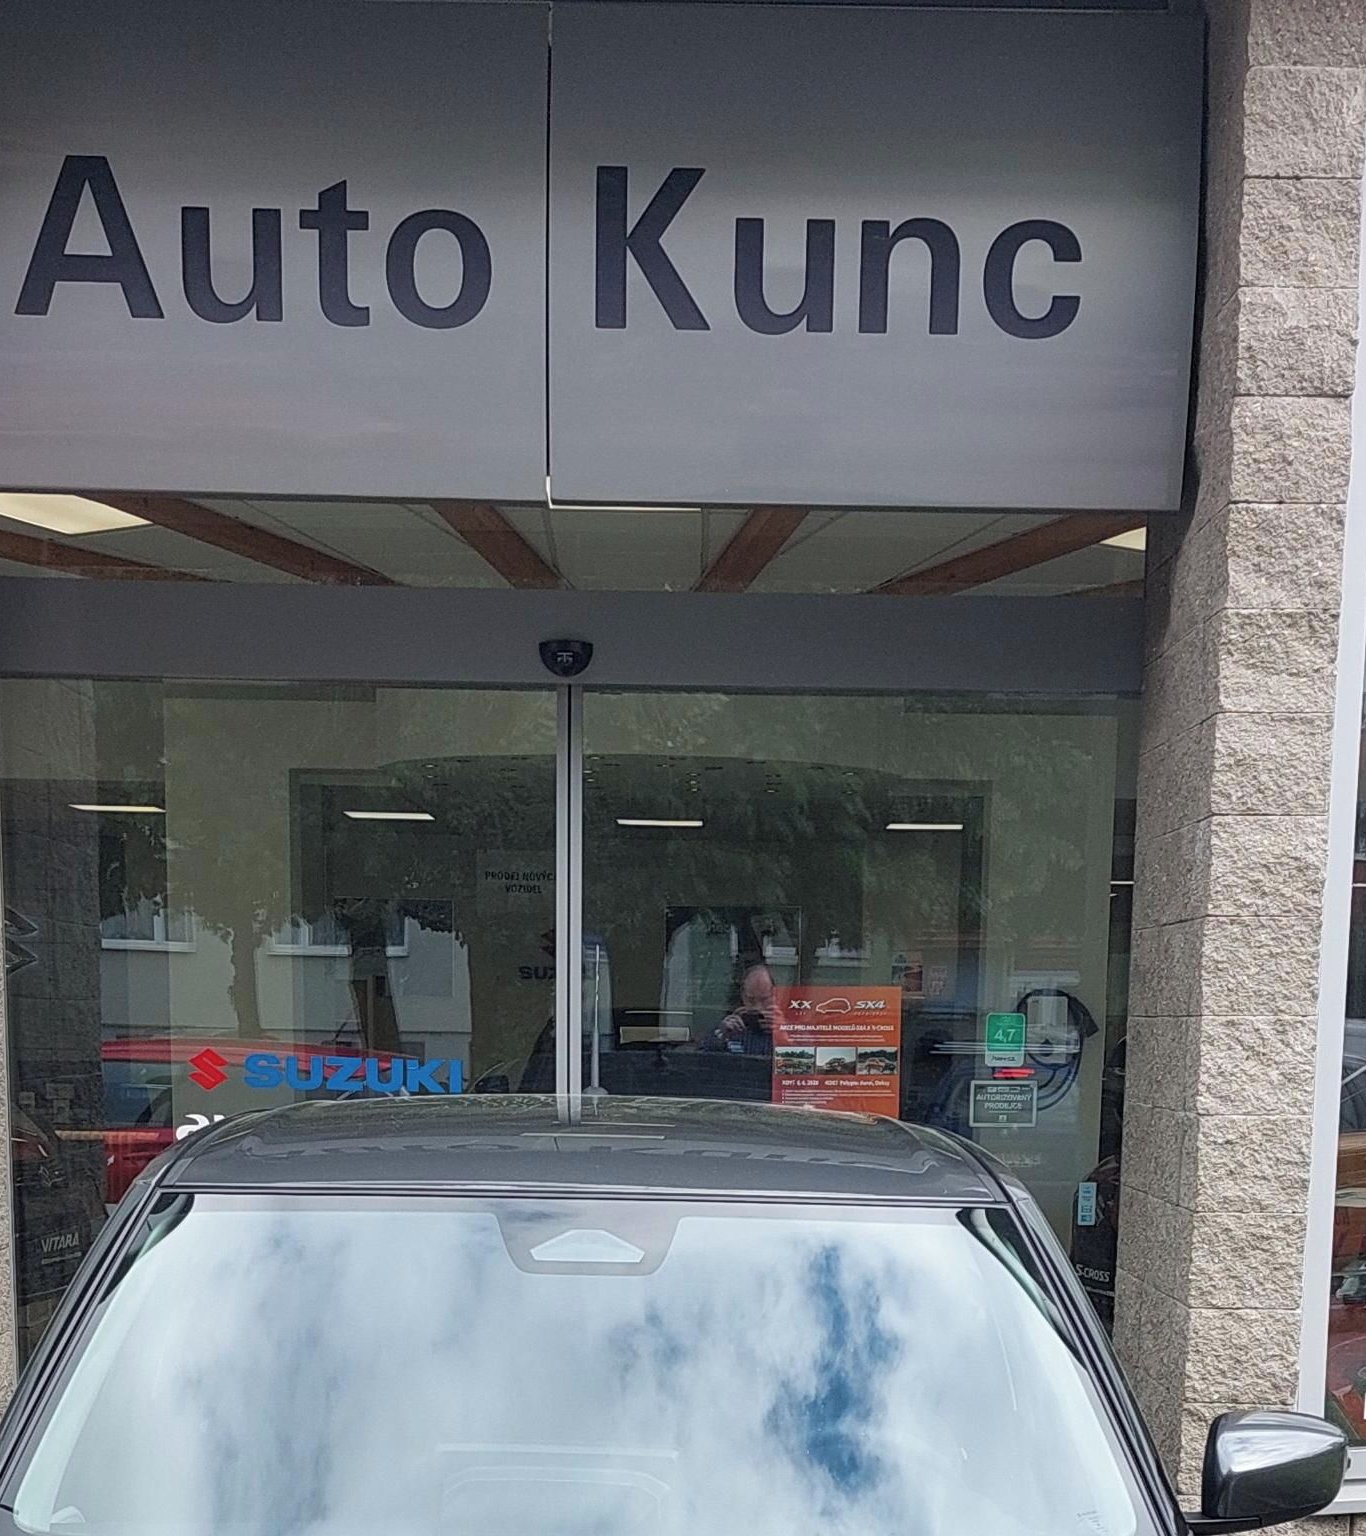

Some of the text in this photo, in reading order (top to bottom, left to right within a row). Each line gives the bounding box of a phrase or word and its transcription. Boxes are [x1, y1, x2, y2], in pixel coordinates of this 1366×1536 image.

[14, 154, 1084, 340] Auto Kunc
[854, 999, 886, 1010] SX4
[994, 1028, 1016, 1043] 4,7
[243, 1053, 464, 1094] SUZUKI
[41, 1231, 80, 1253] VITARA
[1076, 1263, 1111, 1283] S-CROSS
